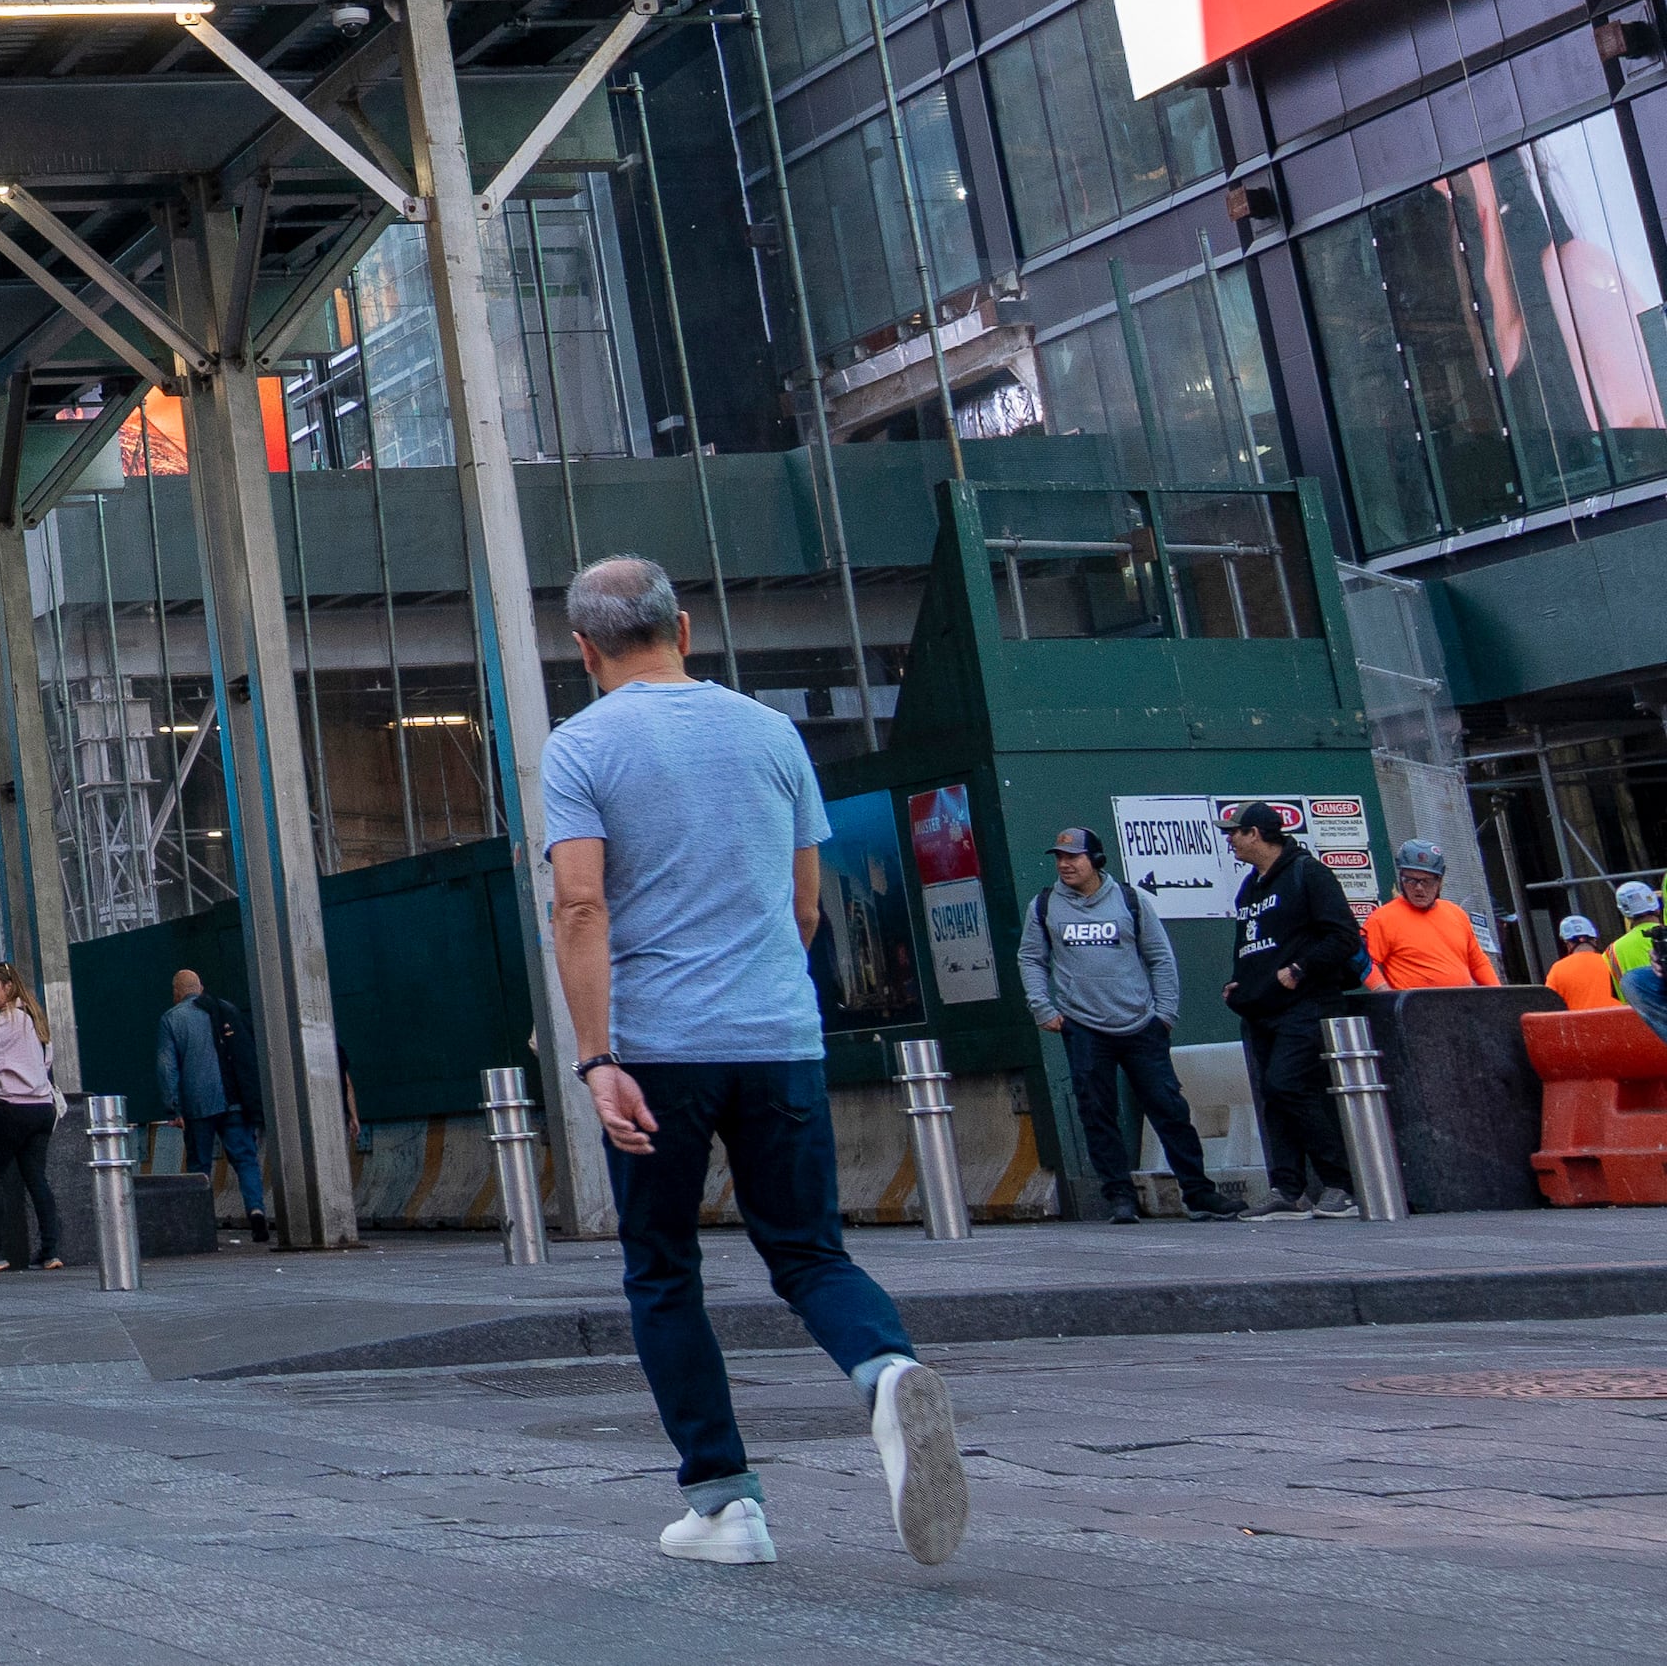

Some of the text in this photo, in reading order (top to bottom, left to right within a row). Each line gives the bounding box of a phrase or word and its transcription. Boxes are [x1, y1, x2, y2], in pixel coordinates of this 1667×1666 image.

[1316, 803, 1354, 813] DANGER
[1124, 821, 1213, 856] PEDESTRIANS
[1326, 855, 1364, 865] DANGER
[1349, 904, 1373, 915] NGER
[931, 901, 980, 944] SUBWAY
[1063, 922, 1117, 940] AERO
